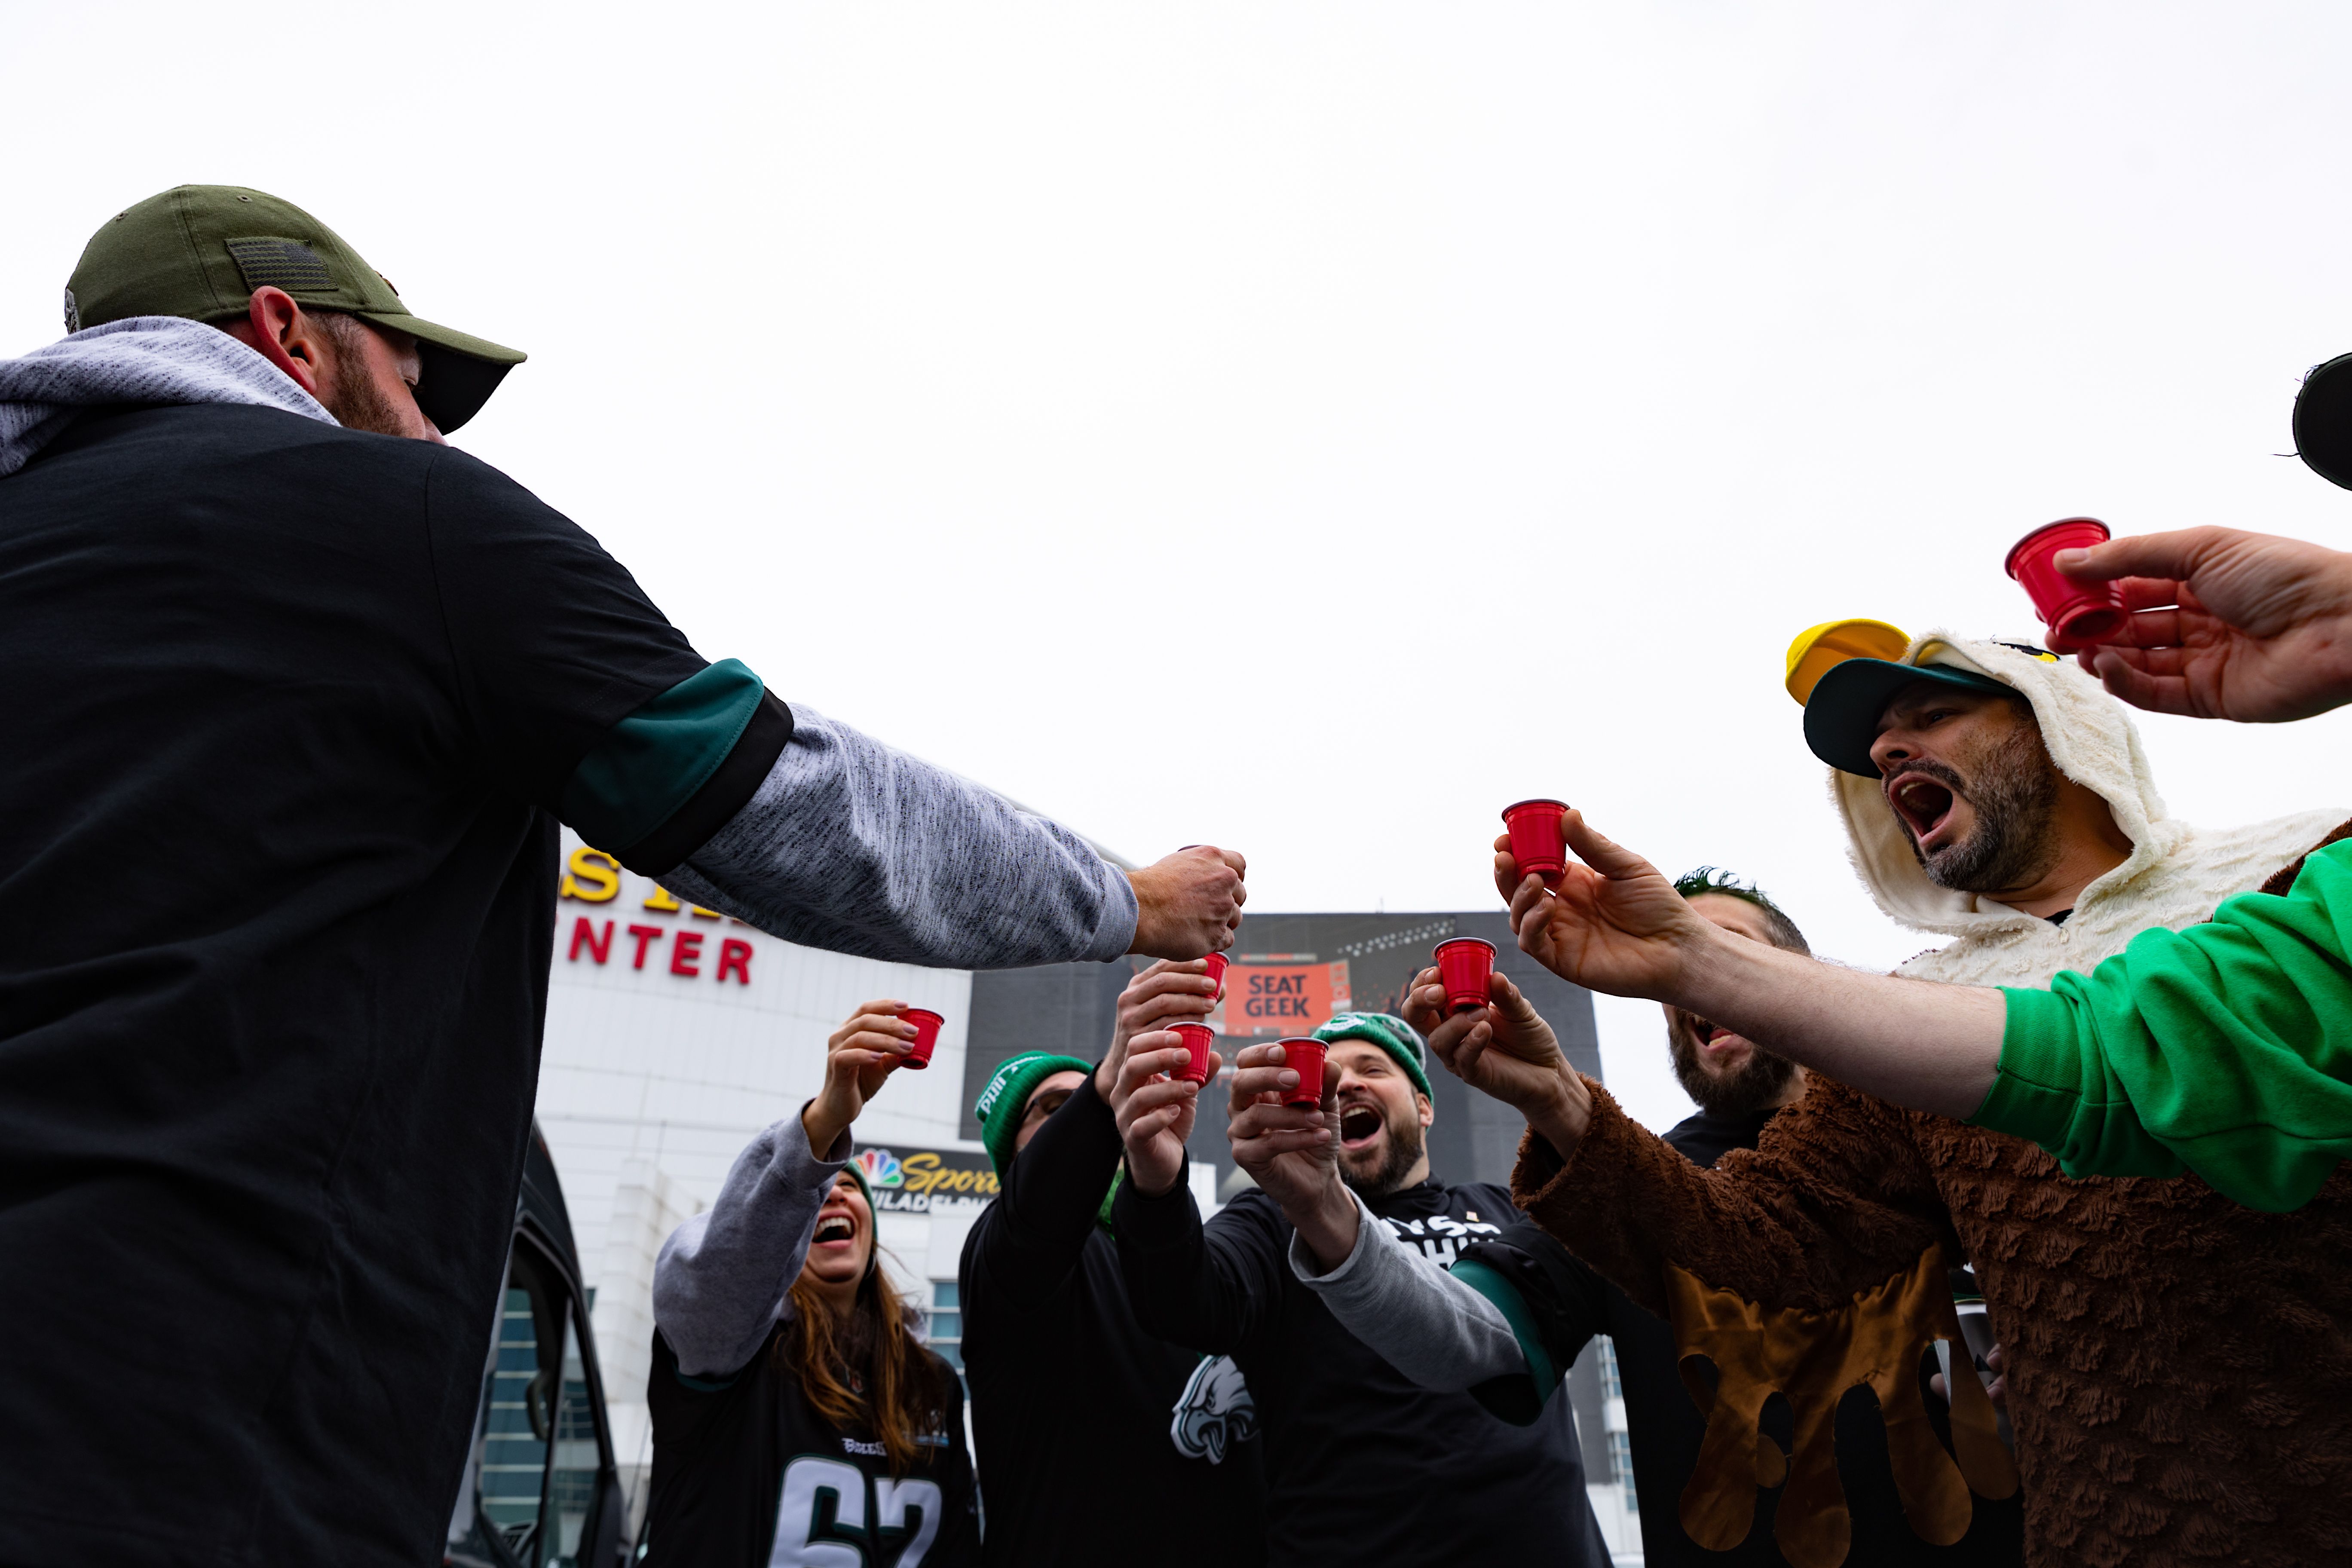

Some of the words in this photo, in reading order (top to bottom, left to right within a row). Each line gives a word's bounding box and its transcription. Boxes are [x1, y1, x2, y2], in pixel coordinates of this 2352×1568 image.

[556, 917, 753, 984] NTER
[1249, 975, 1307, 994] SEAT
[1245, 997, 1310, 1017] GEEK
[902, 1152, 1001, 1197] Sport
